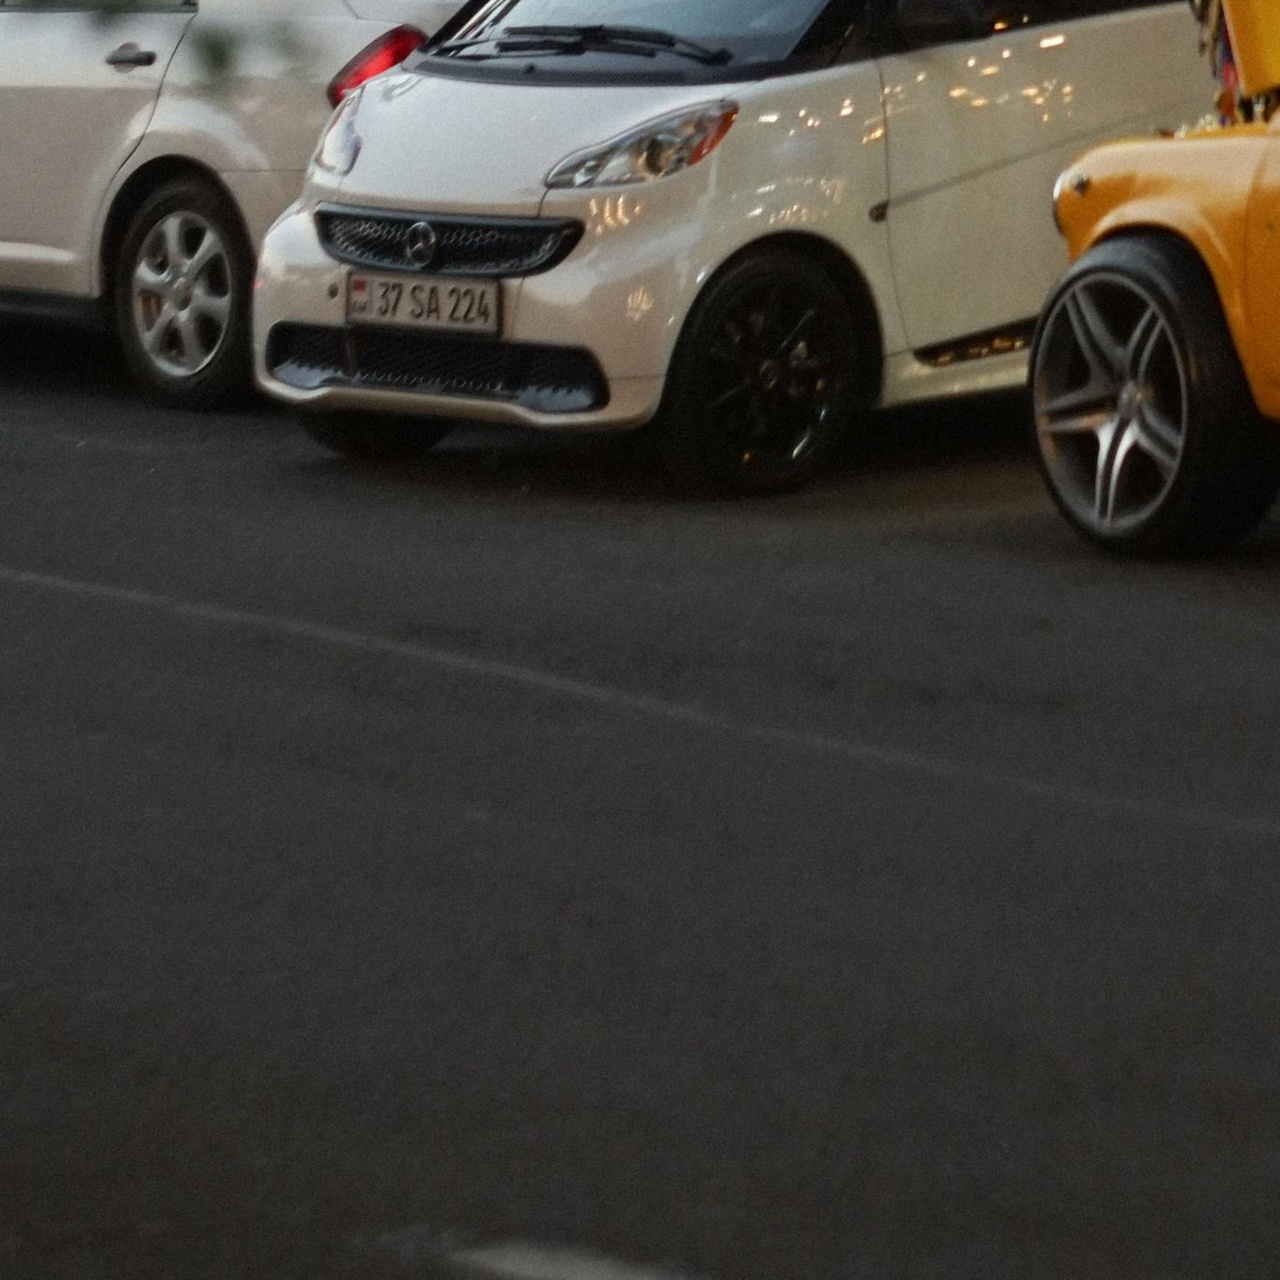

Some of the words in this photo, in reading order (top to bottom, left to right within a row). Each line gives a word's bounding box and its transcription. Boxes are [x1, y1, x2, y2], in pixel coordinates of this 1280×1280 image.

[376, 280, 404, 317] 37
[410, 283, 441, 321] SA
[448, 286, 491, 324] 224
